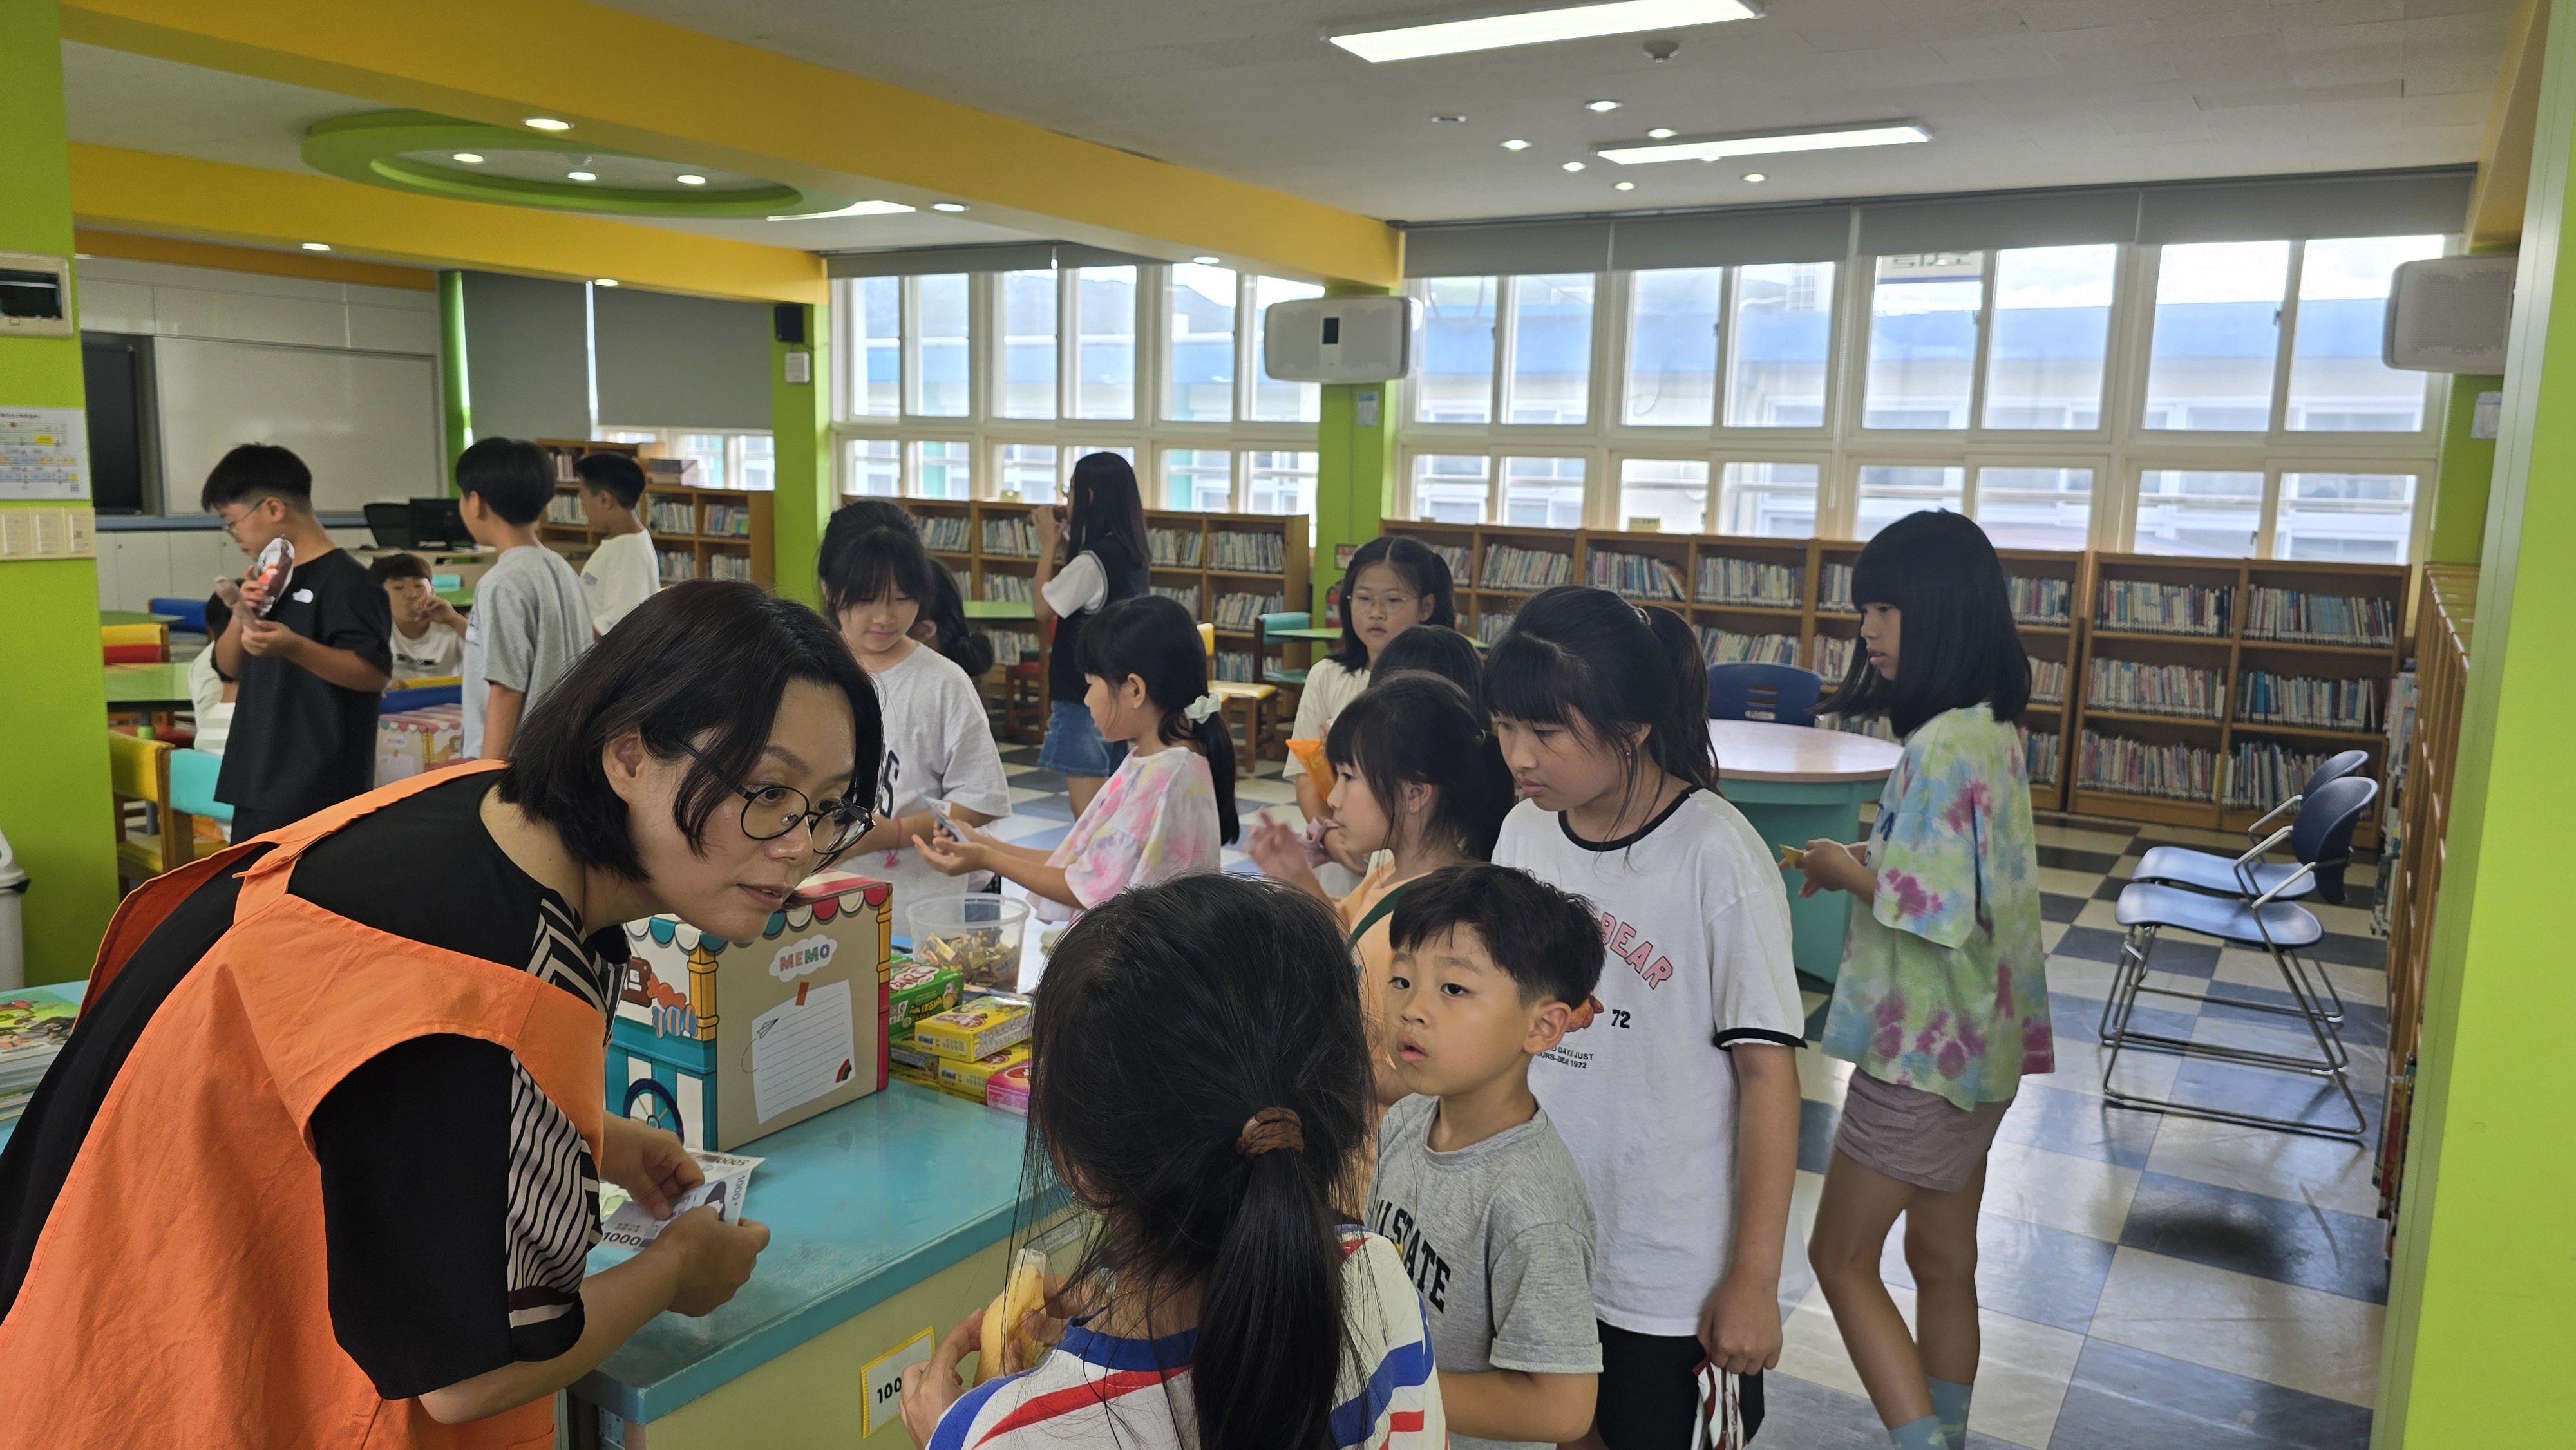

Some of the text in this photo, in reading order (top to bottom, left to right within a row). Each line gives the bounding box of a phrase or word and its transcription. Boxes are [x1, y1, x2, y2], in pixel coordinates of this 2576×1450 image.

[779, 944, 830, 972] MEMO
[1600, 911, 1673, 990] BEAR
[1611, 1009, 1631, 1029] 72
[1571, 1060, 1587, 1069] 1972
[1574, 1051, 1594, 1060] JUST
[732, 1175, 745, 1201] 1000
[603, 1231, 641, 1245] 1000
[1392, 1208, 1452, 1314] STATE
